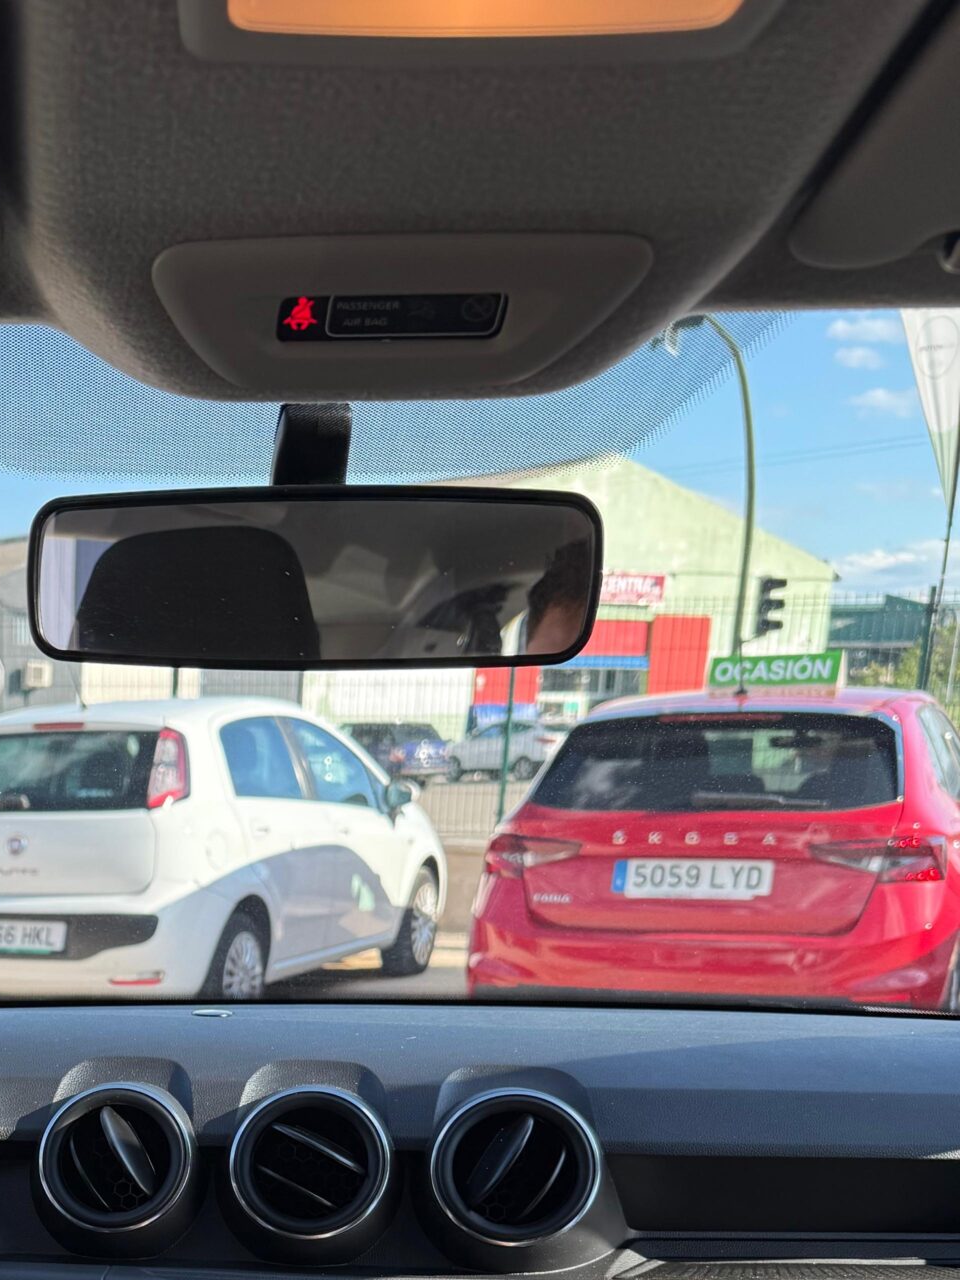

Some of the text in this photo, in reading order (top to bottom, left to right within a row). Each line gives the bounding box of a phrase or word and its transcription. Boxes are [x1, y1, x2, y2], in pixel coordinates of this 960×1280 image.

[336, 301, 399, 311] PASSENGER
[343, 317, 387, 327] AIR BAG
[714, 655, 832, 682] OCASIÓN
[633, 864, 763, 890] 5059 LYD
[20, 924, 54, 947] HKL
